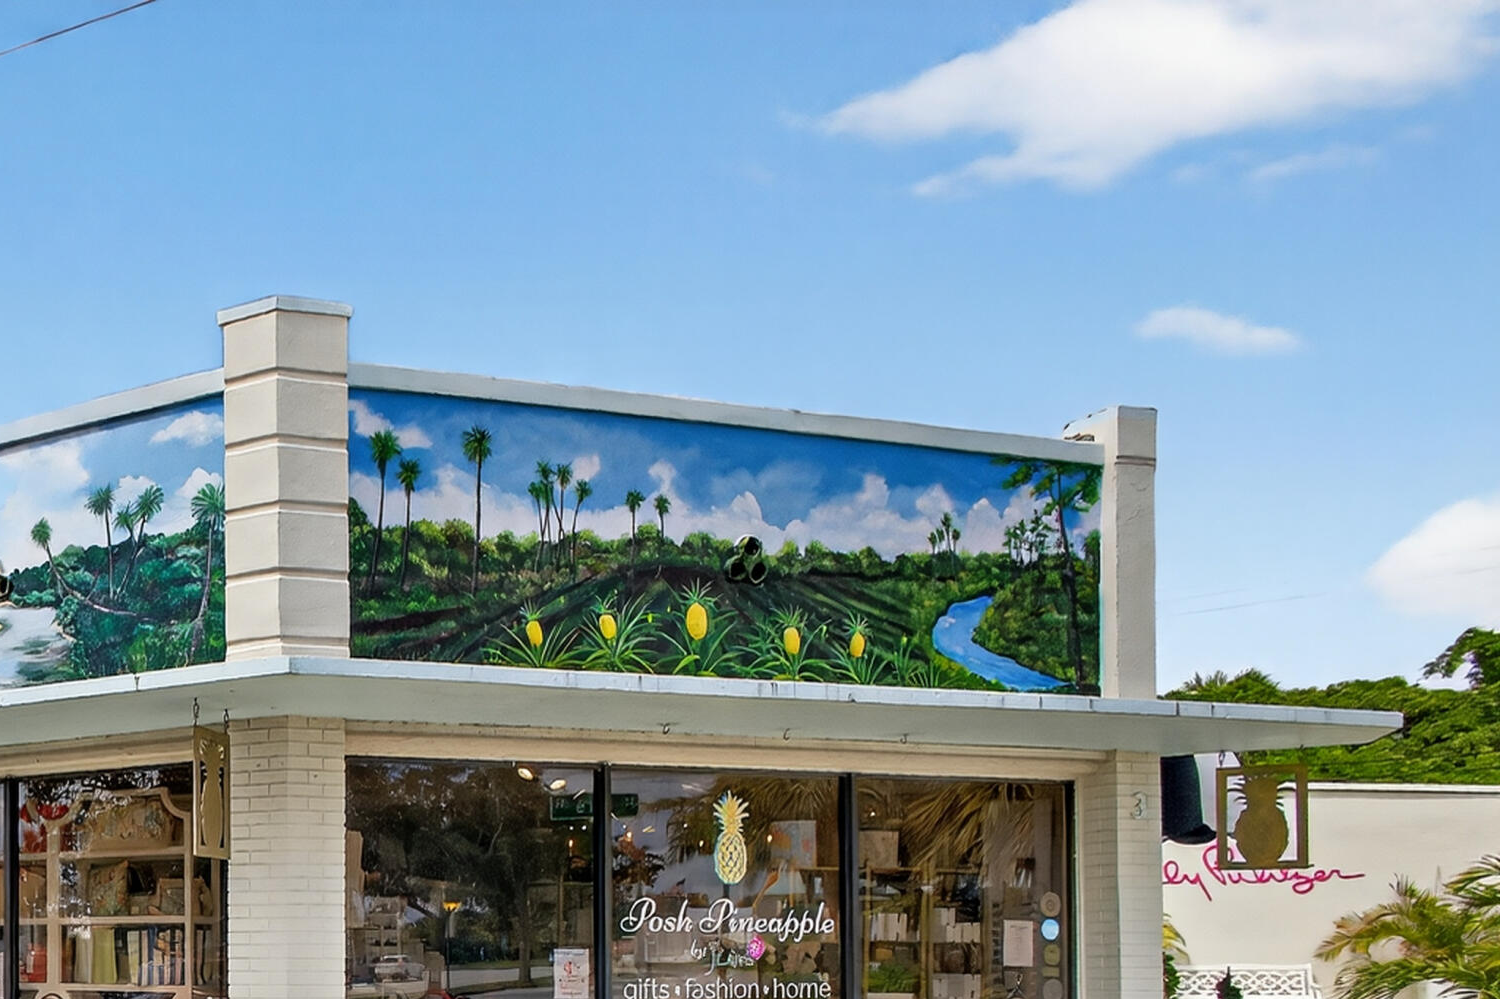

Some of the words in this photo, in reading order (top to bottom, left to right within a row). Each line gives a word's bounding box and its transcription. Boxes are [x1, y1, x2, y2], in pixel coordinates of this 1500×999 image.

[620, 897, 693, 933] Posh
[700, 898, 835, 943] Pineapple
[686, 978, 759, 999] fashion
[773, 978, 831, 999] home
